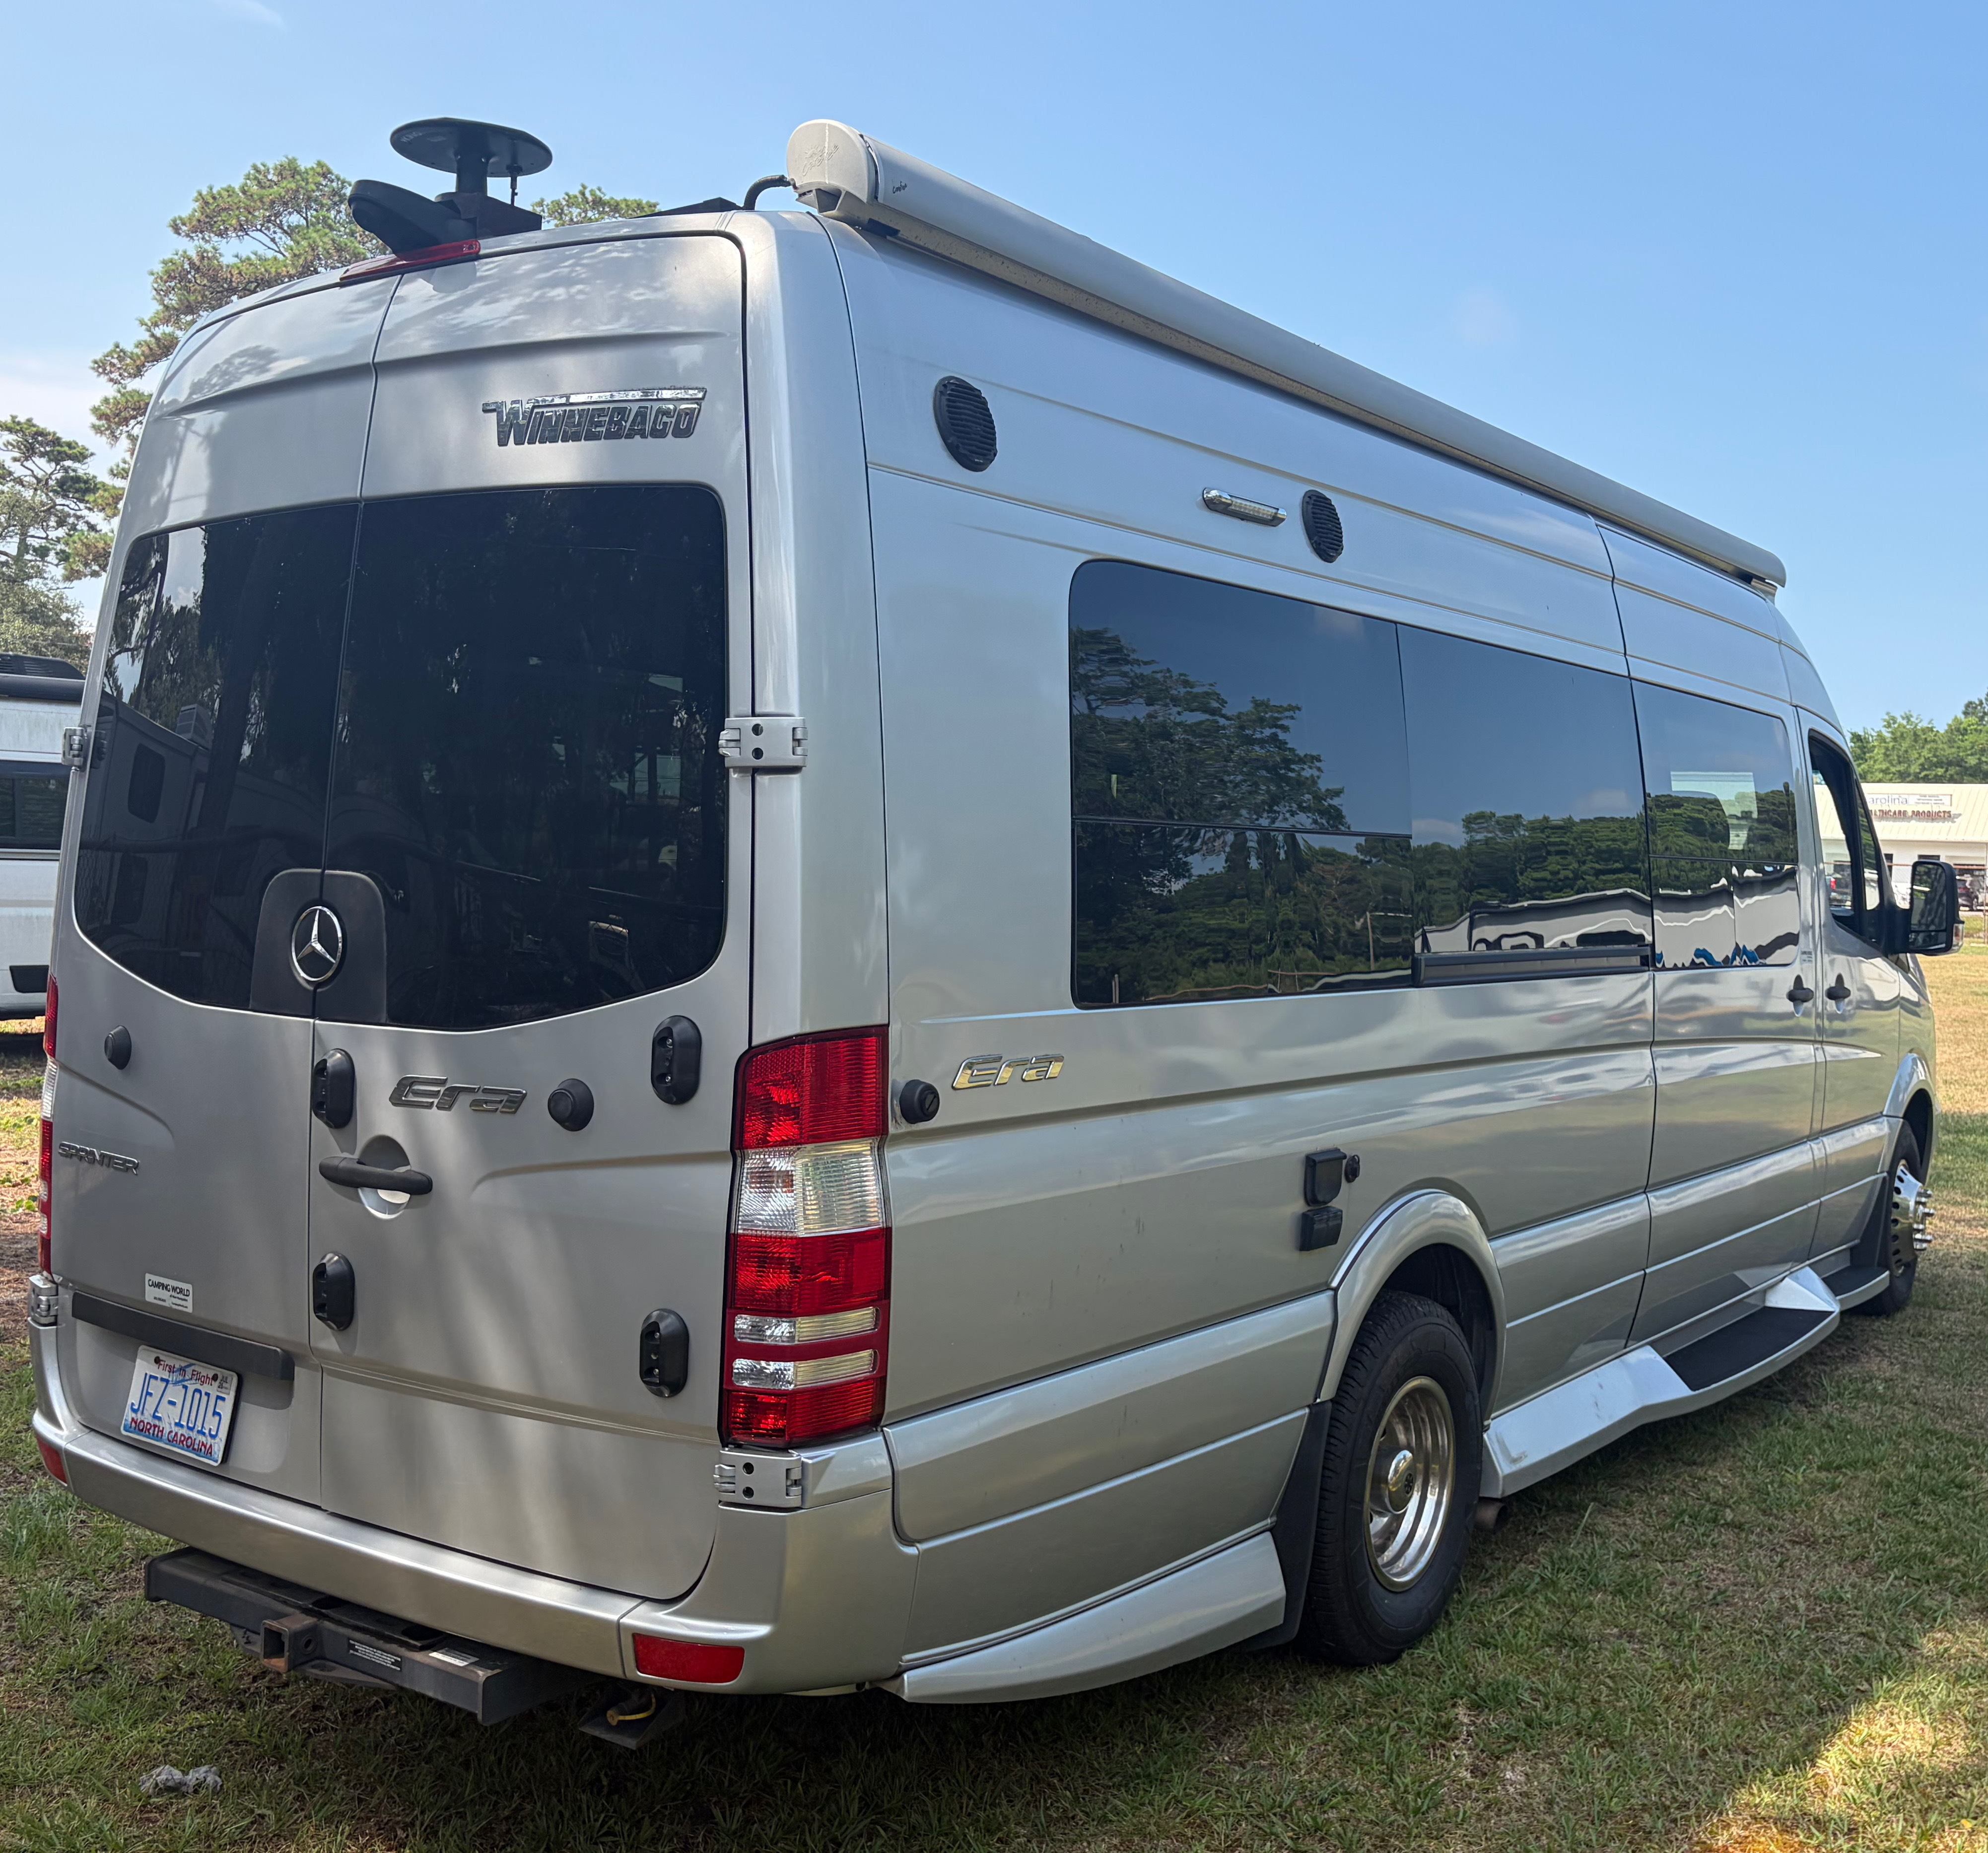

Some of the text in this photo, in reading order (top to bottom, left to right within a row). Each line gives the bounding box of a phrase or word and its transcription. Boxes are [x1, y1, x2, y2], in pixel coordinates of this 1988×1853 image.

[1868, 794, 1908, 805] arolina
[1869, 809, 1908, 818] LTHCARE
[952, 1054, 1064, 1091] Era
[389, 1075, 527, 1114] Era
[58, 1141, 138, 1175] SPRINTER
[148, 1279, 190, 1297] CAMPING WORLD
[157, 1359, 175, 1373] First
[191, 1369, 213, 1386] Flight
[130, 1372, 226, 1440] JFZ-1015
[129, 1417, 213, 1456] NORTH CAROLINA
